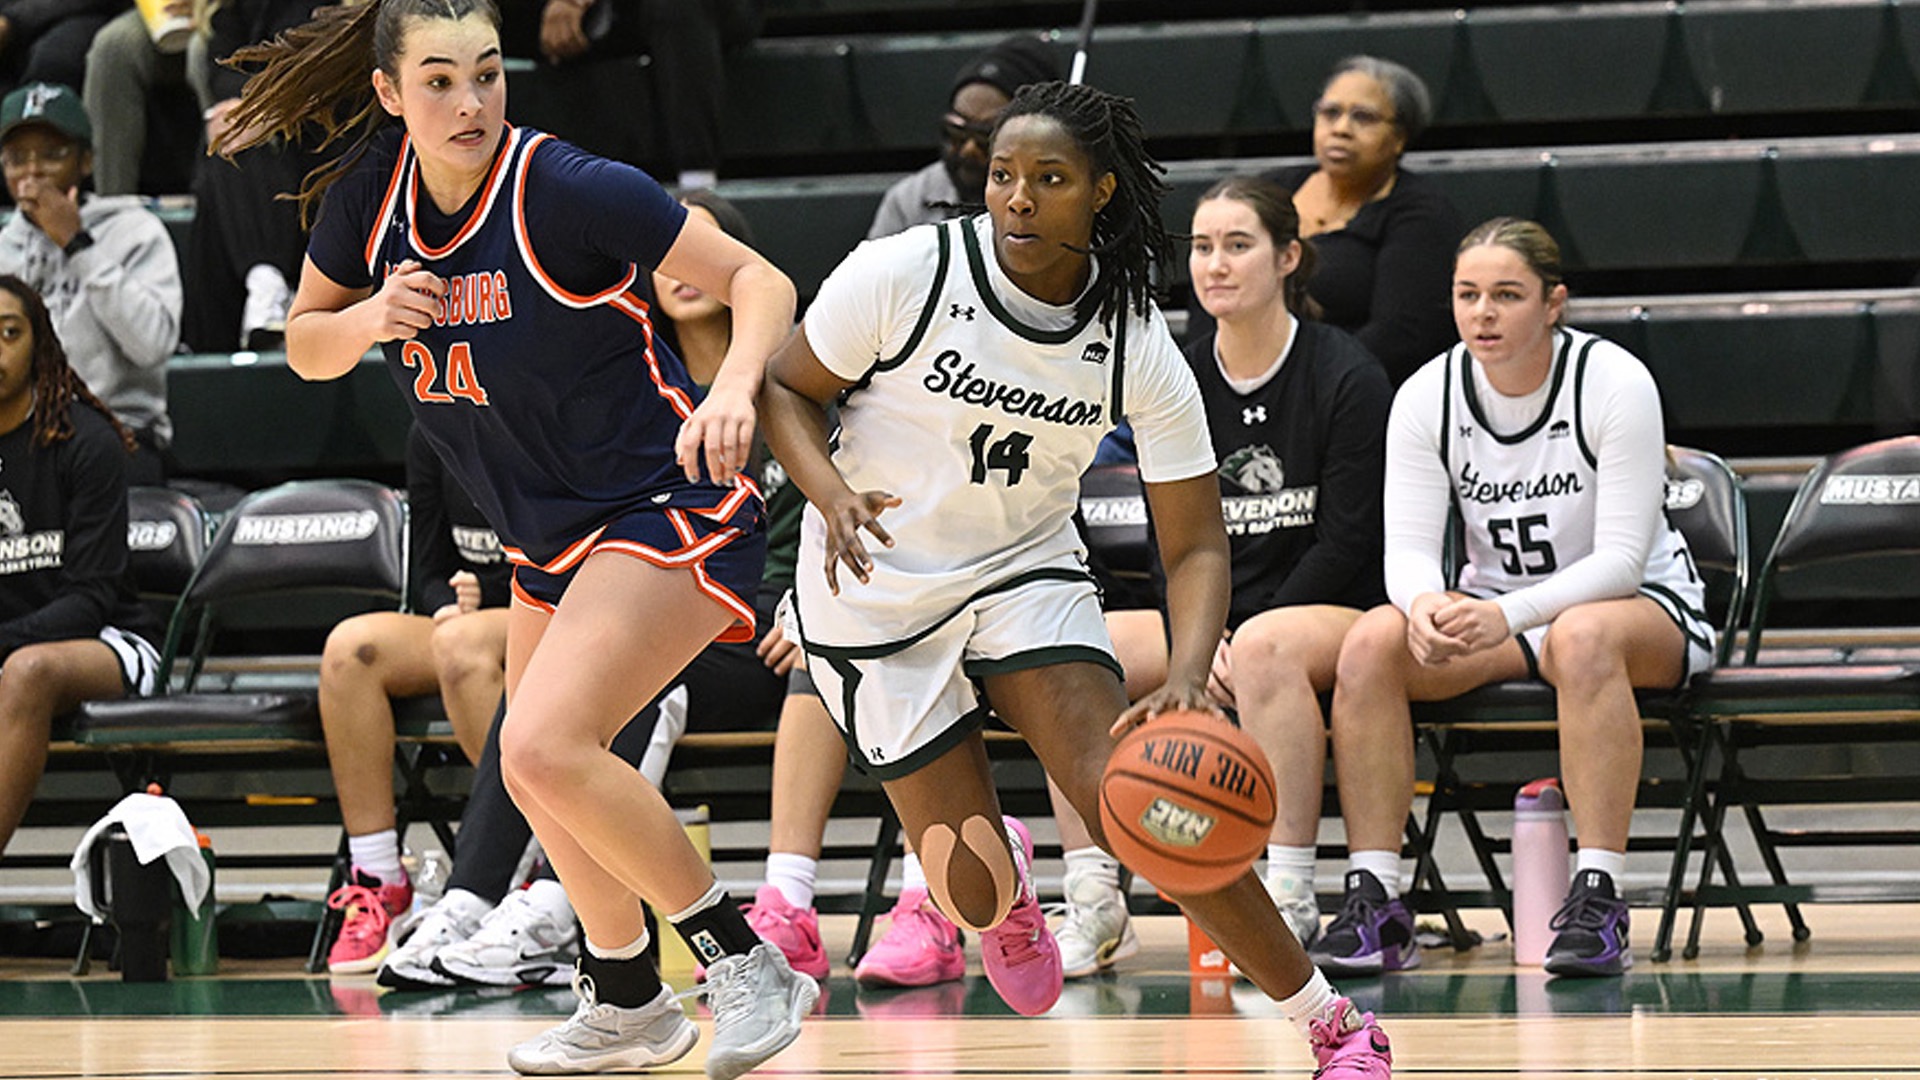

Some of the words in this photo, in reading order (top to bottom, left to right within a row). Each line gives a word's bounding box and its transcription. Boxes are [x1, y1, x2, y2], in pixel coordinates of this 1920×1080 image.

[402, 340, 490, 405] 24
[924, 349, 1102, 426] Stevenson
[969, 423, 1034, 487] 14
[236, 511, 378, 542] MUSTANGS
[1487, 513, 1557, 576] 55
[1140, 740, 1204, 780] ROCK
[1210, 752, 1256, 801] THE
